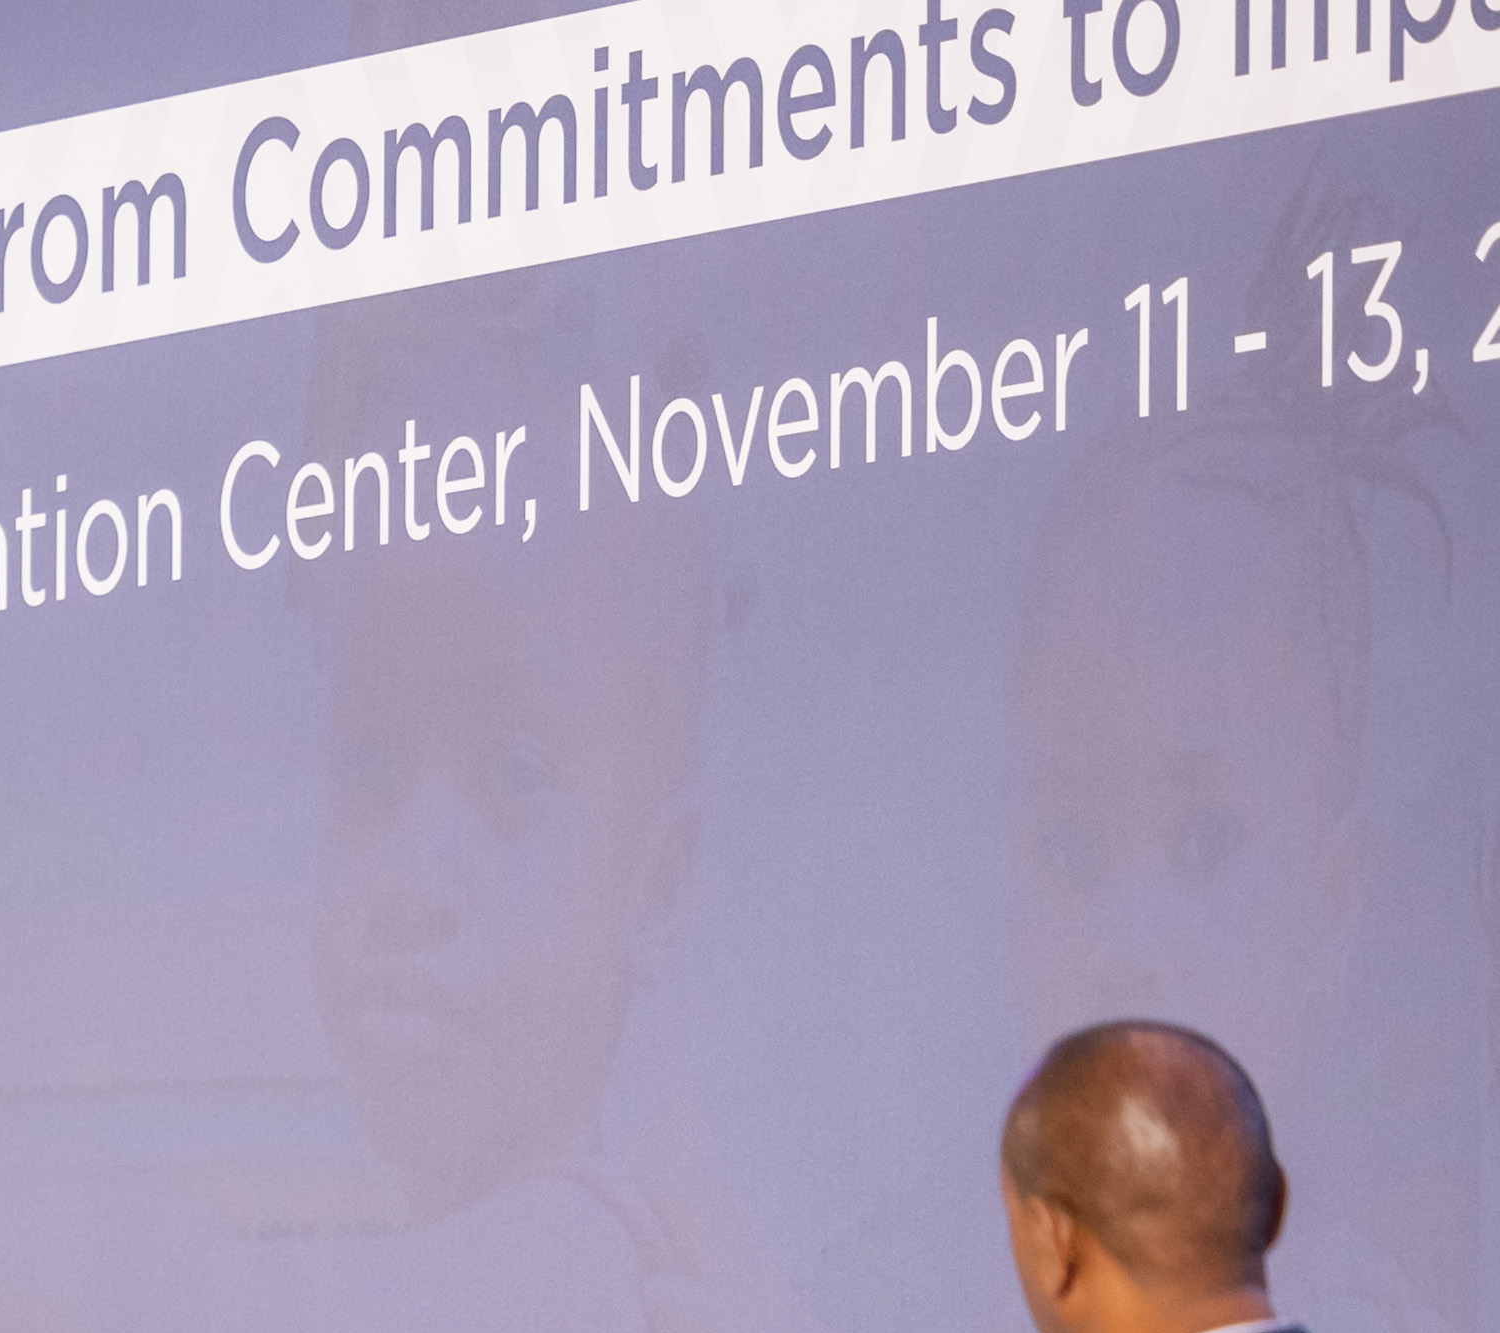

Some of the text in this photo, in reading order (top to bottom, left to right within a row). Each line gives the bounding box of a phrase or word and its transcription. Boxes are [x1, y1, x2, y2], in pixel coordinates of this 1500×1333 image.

[233, 0, 1017, 264] Commitments
[1063, 0, 1181, 107] to
[221, 420, 537, 570] Center,
[580, 317, 1089, 512] November
[1124, 277, 1188, 418] 11
[1306, 241, 1429, 395] 13,
